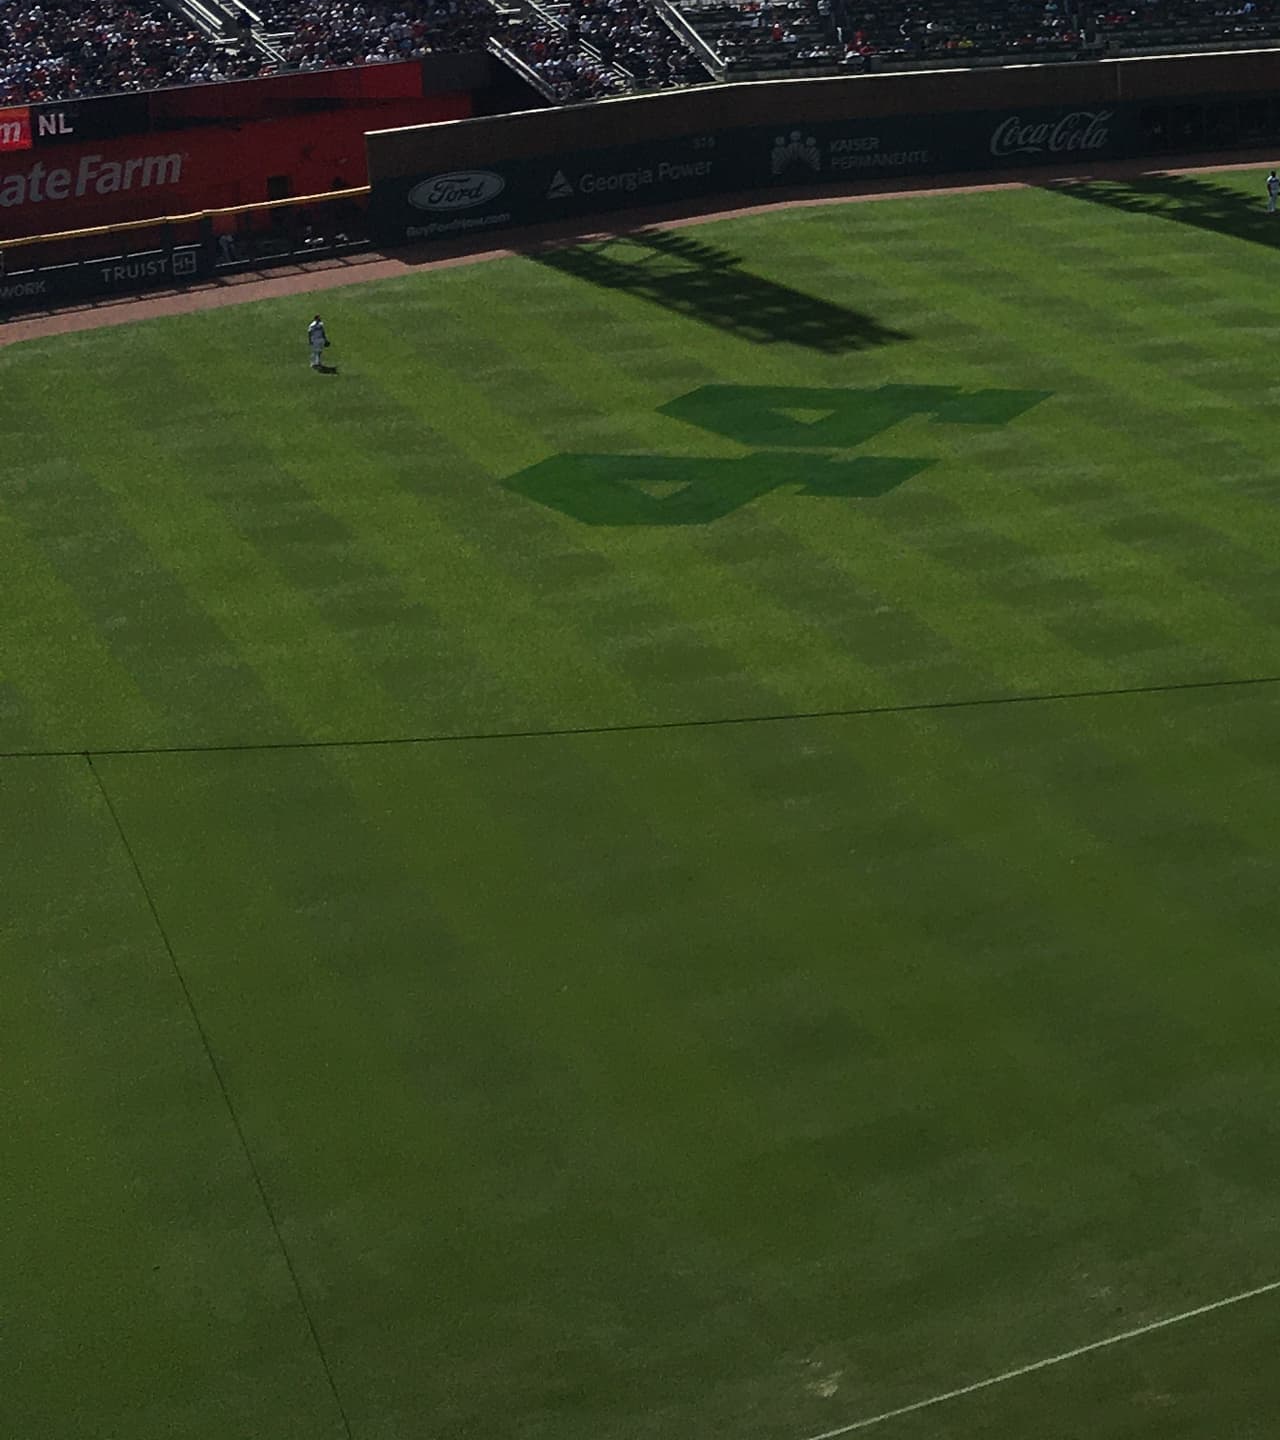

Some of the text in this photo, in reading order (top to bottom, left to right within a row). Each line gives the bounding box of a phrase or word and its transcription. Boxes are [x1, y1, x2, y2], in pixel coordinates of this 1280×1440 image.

[38, 113, 74, 137] NL
[829, 136, 881, 153] KAISER
[580, 160, 712, 193] Georgia Power
[428, 177, 485, 204] Ford
[100, 259, 168, 283] TRUIST
